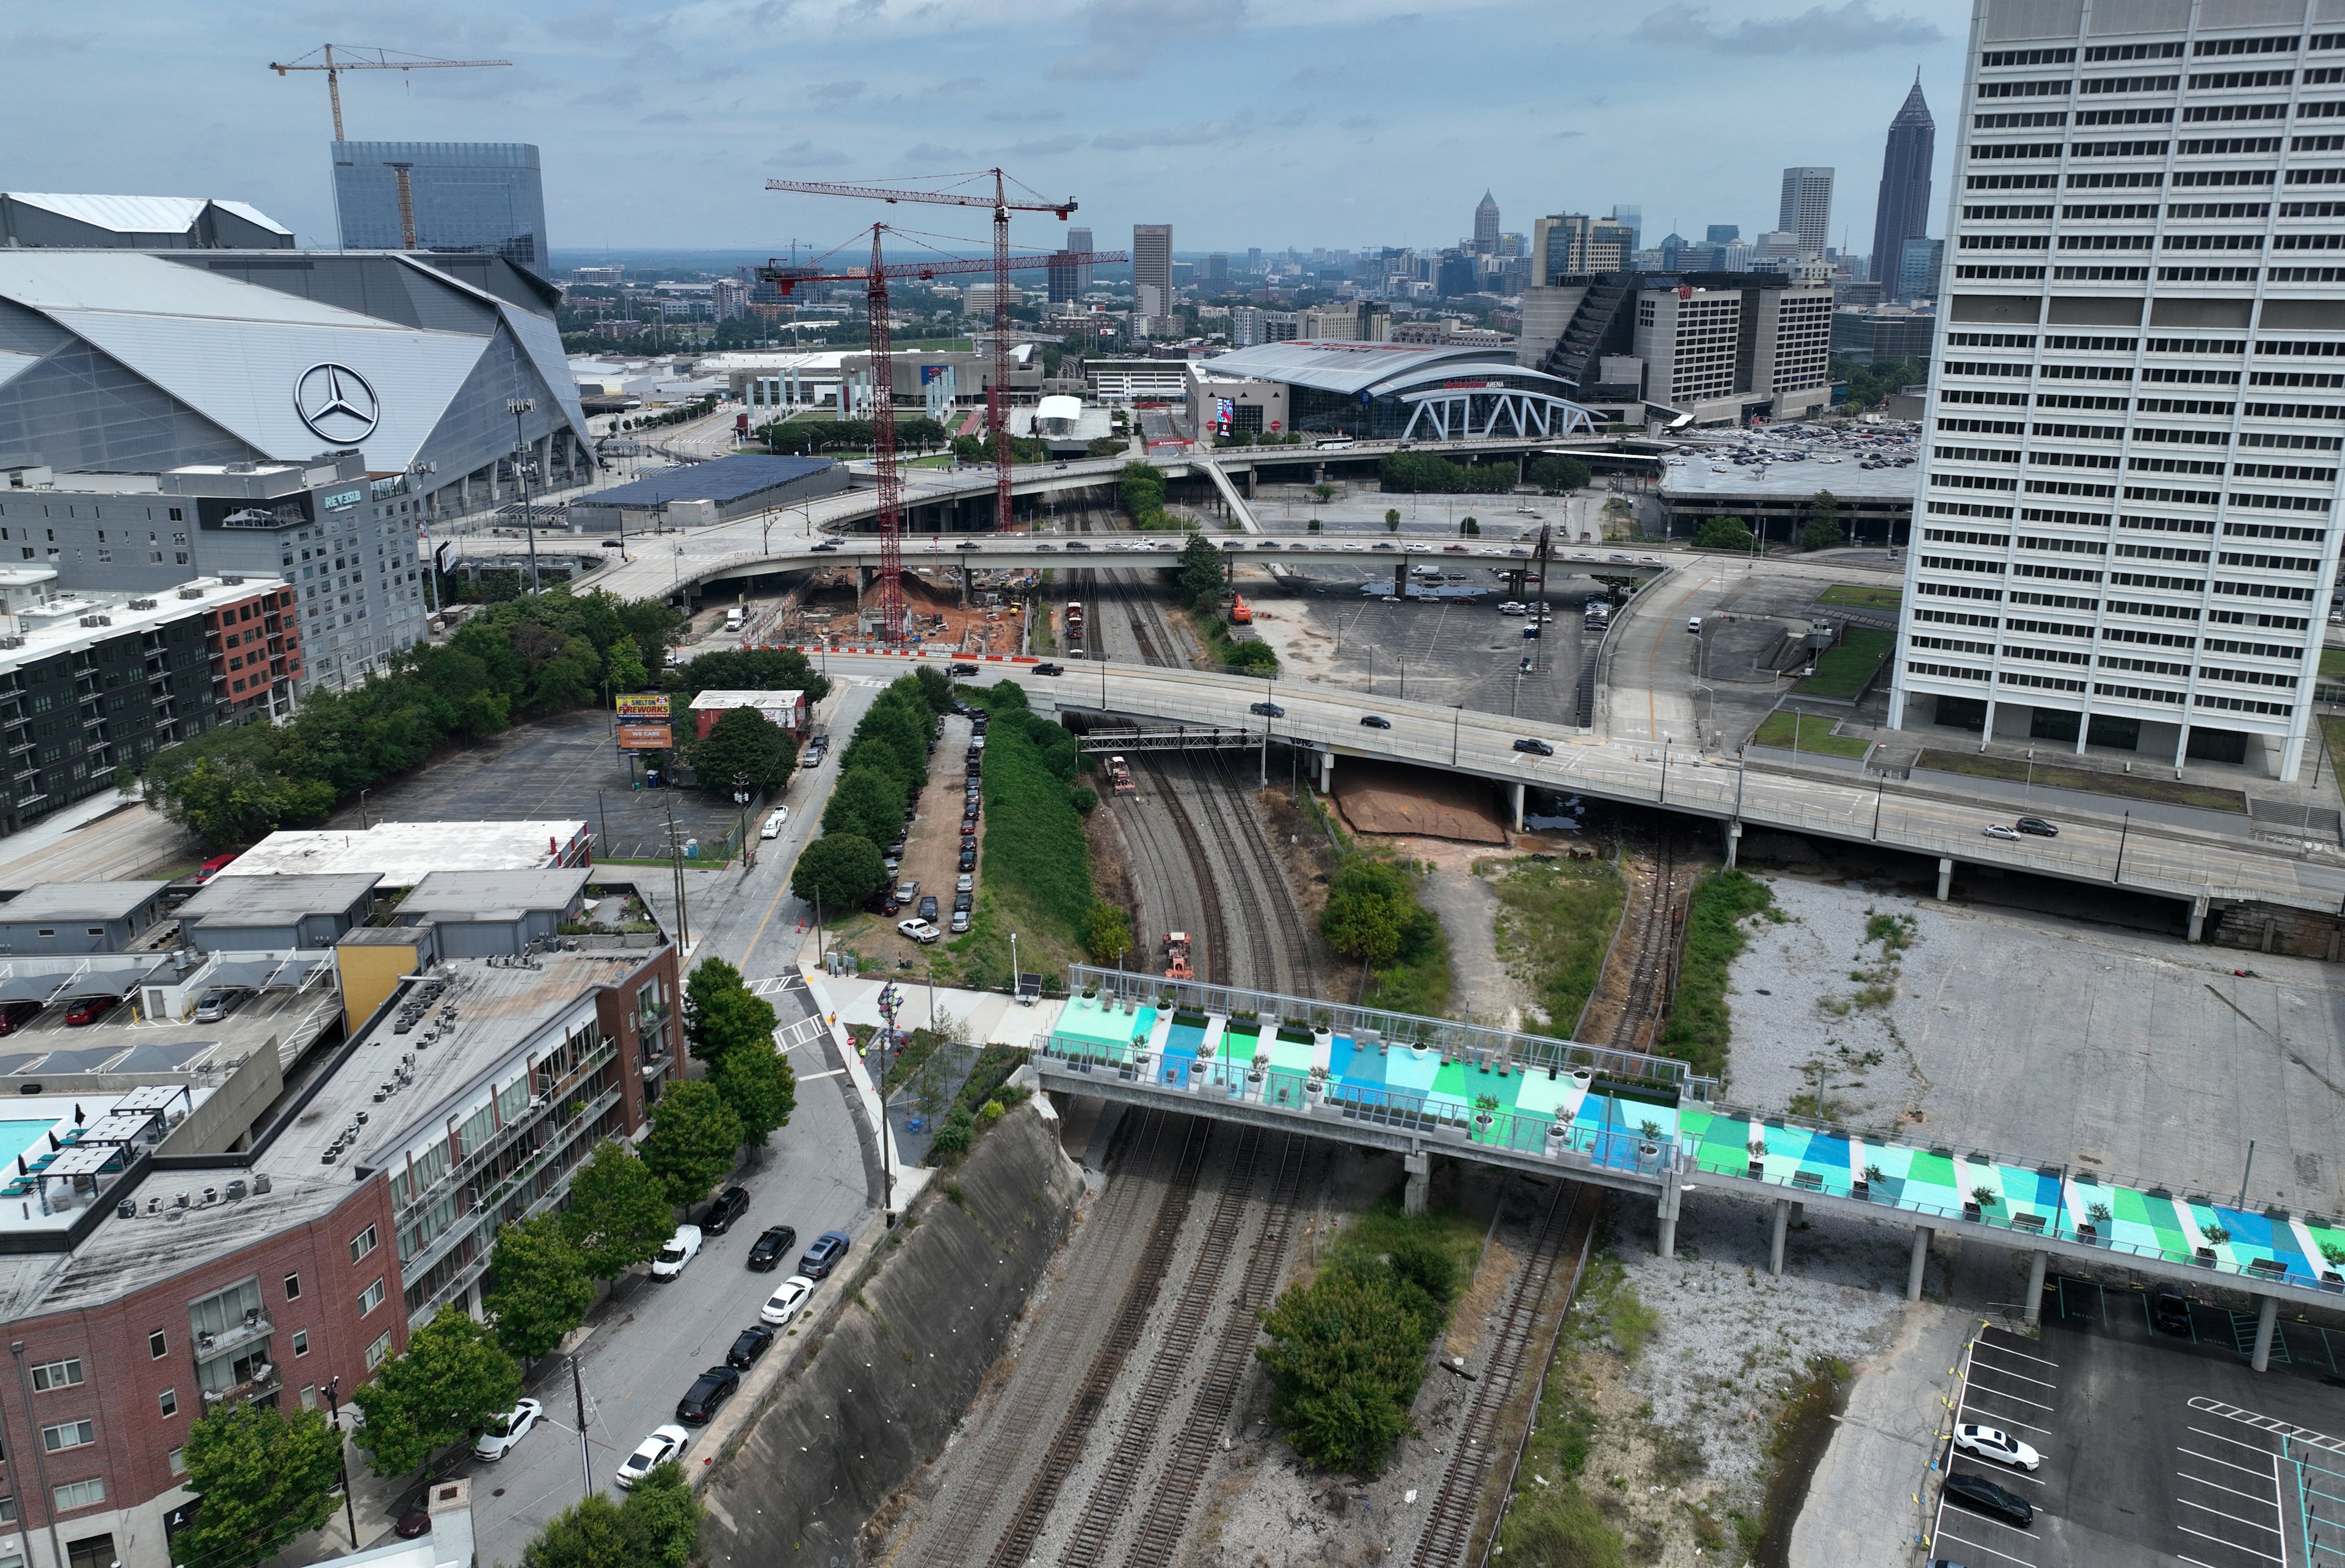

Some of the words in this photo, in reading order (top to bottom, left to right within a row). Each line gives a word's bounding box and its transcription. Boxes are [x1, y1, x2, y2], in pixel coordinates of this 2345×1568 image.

[847, 267, 867, 277] CIM
[2072, 1312, 2096, 1321] RETAIL
[2203, 1337, 2230, 1346] RETAIL
